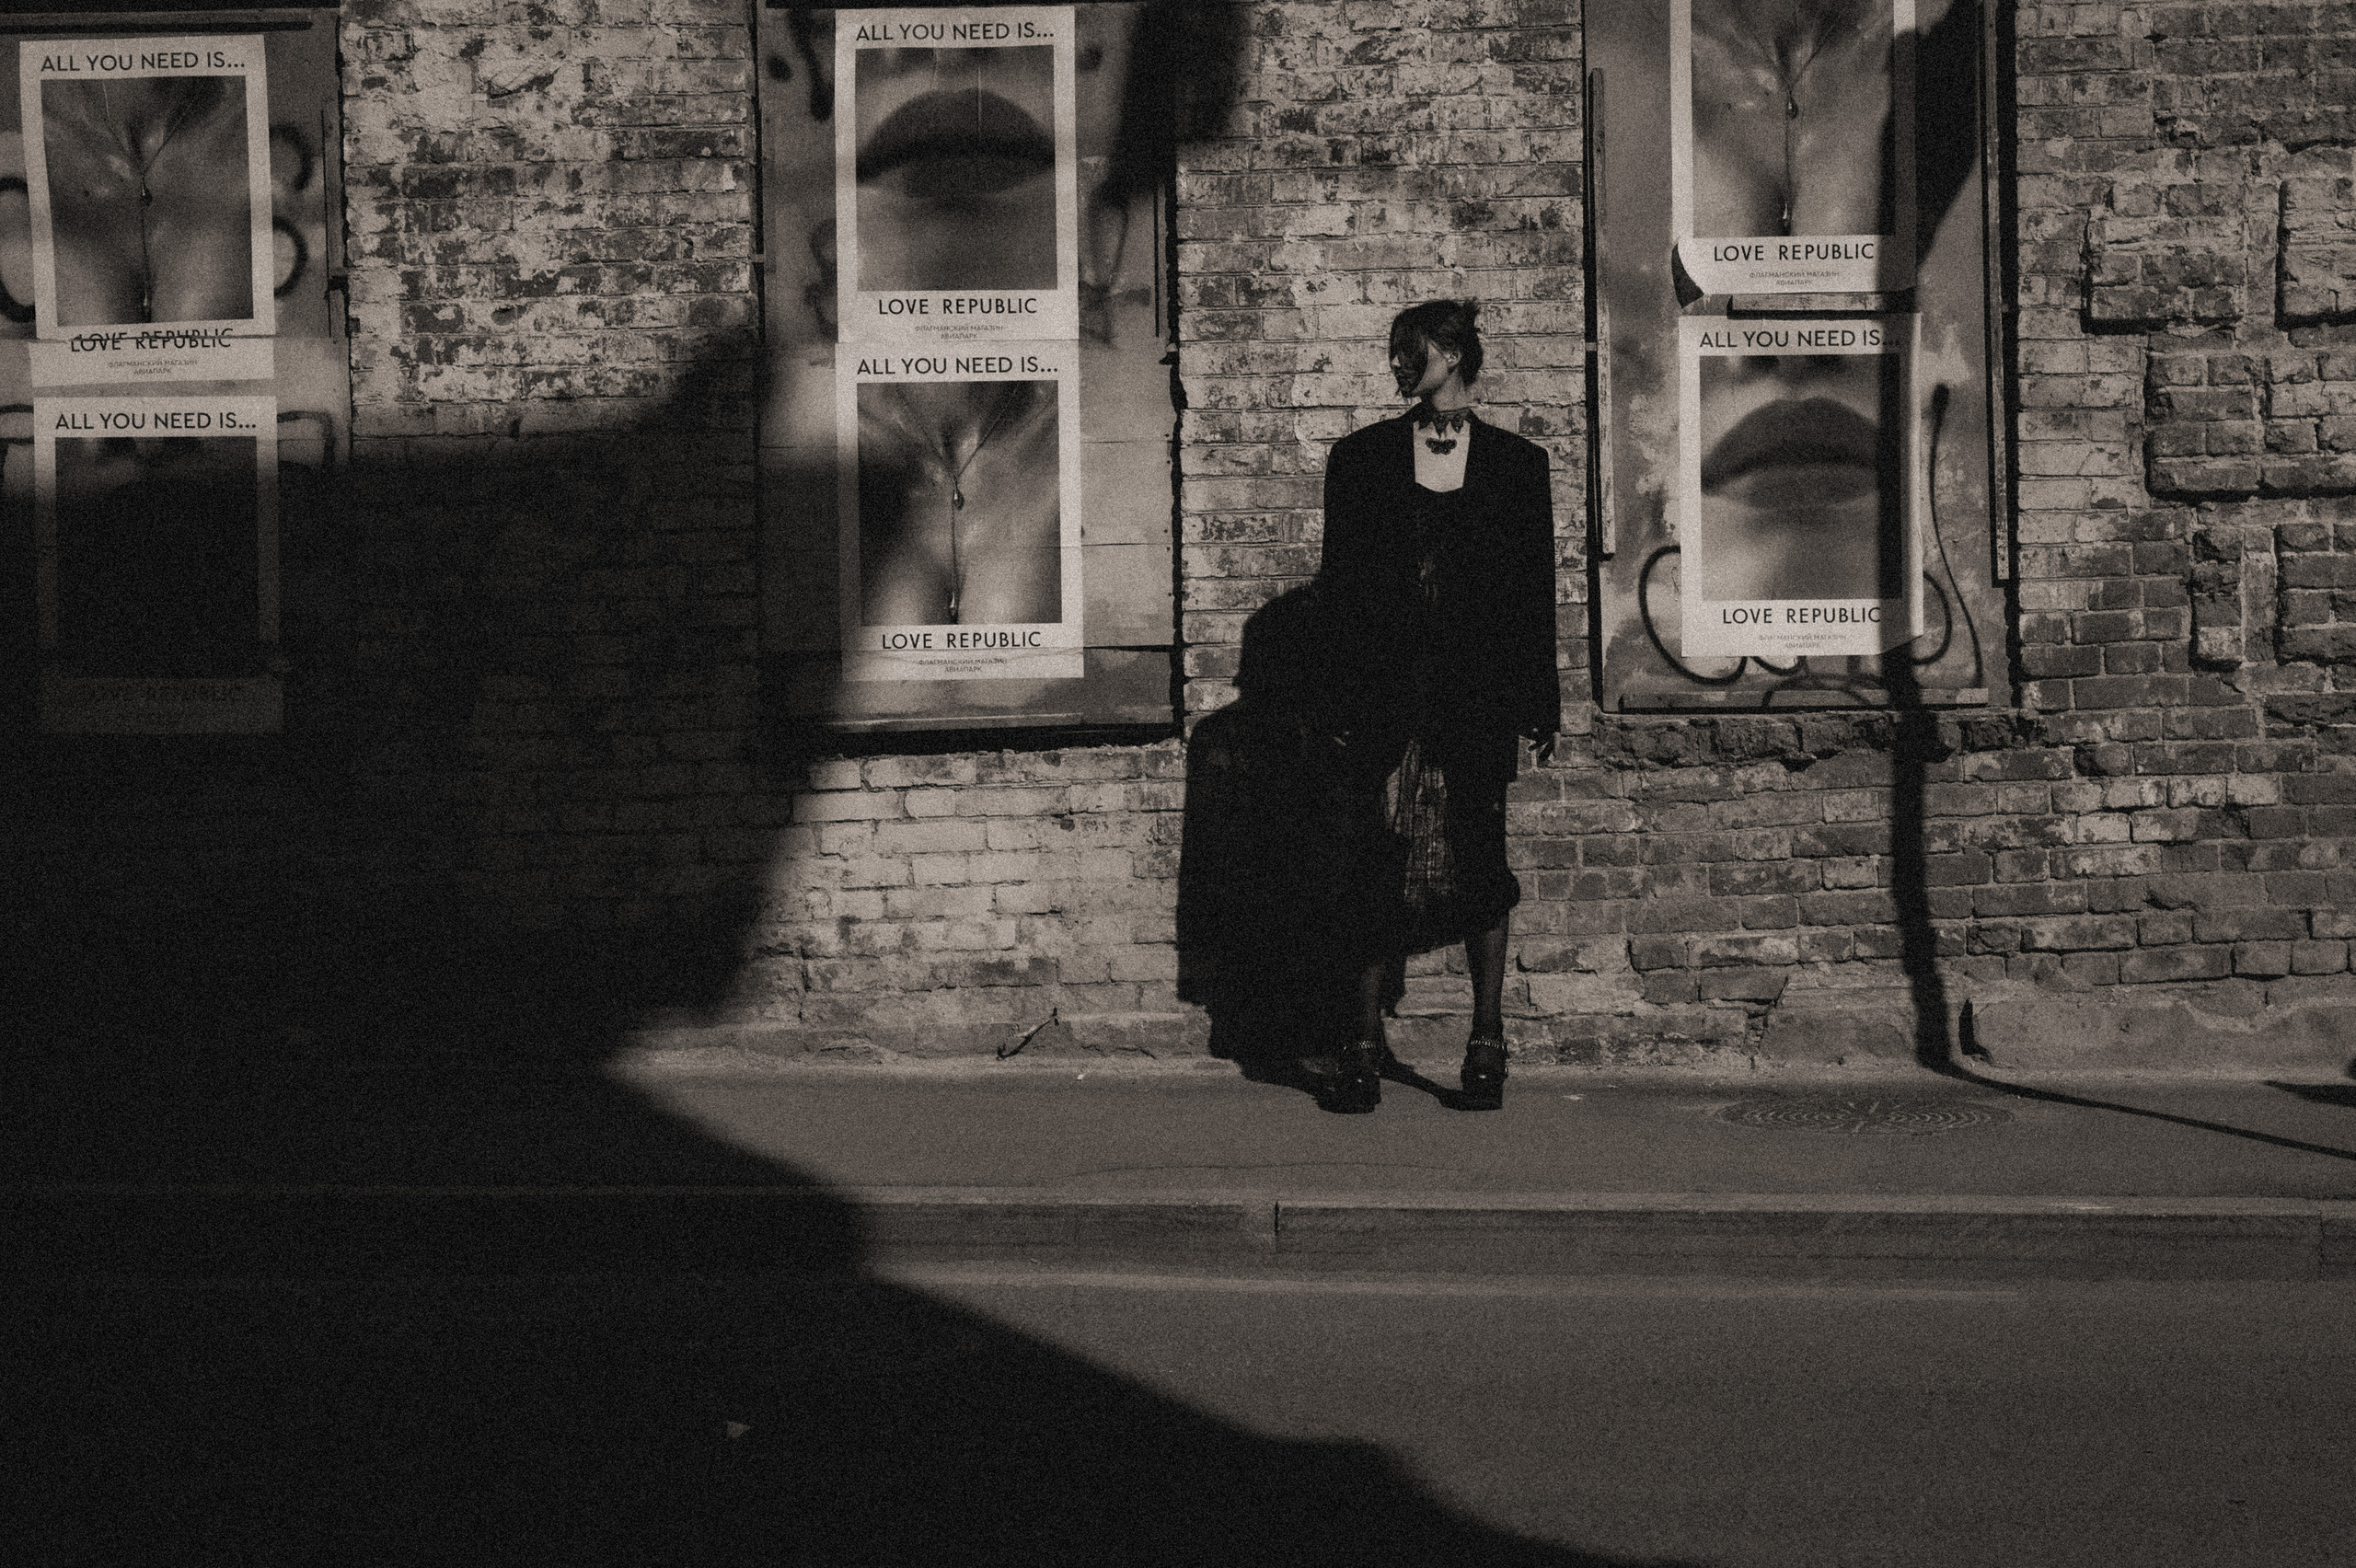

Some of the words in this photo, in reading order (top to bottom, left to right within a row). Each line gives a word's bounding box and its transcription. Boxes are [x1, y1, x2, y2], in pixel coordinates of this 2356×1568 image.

[856, 25, 894, 41] ALL
[899, 24, 944, 40] YOU
[953, 23, 1010, 40] NEED
[1017, 22, 1055, 38] IS...
[40, 55, 81, 72] ALL
[86, 54, 133, 71] YOU
[141, 52, 199, 69] NEED
[206, 51, 246, 68] IS...
[1714, 245, 1764, 261] LOVE
[1778, 243, 1875, 260] REPUBLIC
[878, 299, 929, 315] LOVE
[942, 297, 1037, 314] REPUBLIC
[1700, 331, 1738, 348] ALL
[1743, 330, 1789, 347] YOU
[1797, 329, 1855, 347] NEED
[857, 359, 895, 375] ALL
[901, 357, 947, 374] YOU
[955, 356, 1012, 374] NEED
[1021, 356, 1058, 373] IS...
[55, 413, 95, 430] ALL
[99, 412, 145, 429] YOU
[154, 412, 212, 429] NEED
[219, 412, 257, 429] IS...
[1723, 608, 1773, 624] LOVE
[1786, 607, 1881, 624] REPUBLIC
[882, 633, 932, 650] LOVE
[947, 631, 1042, 649] REPUBLIC
